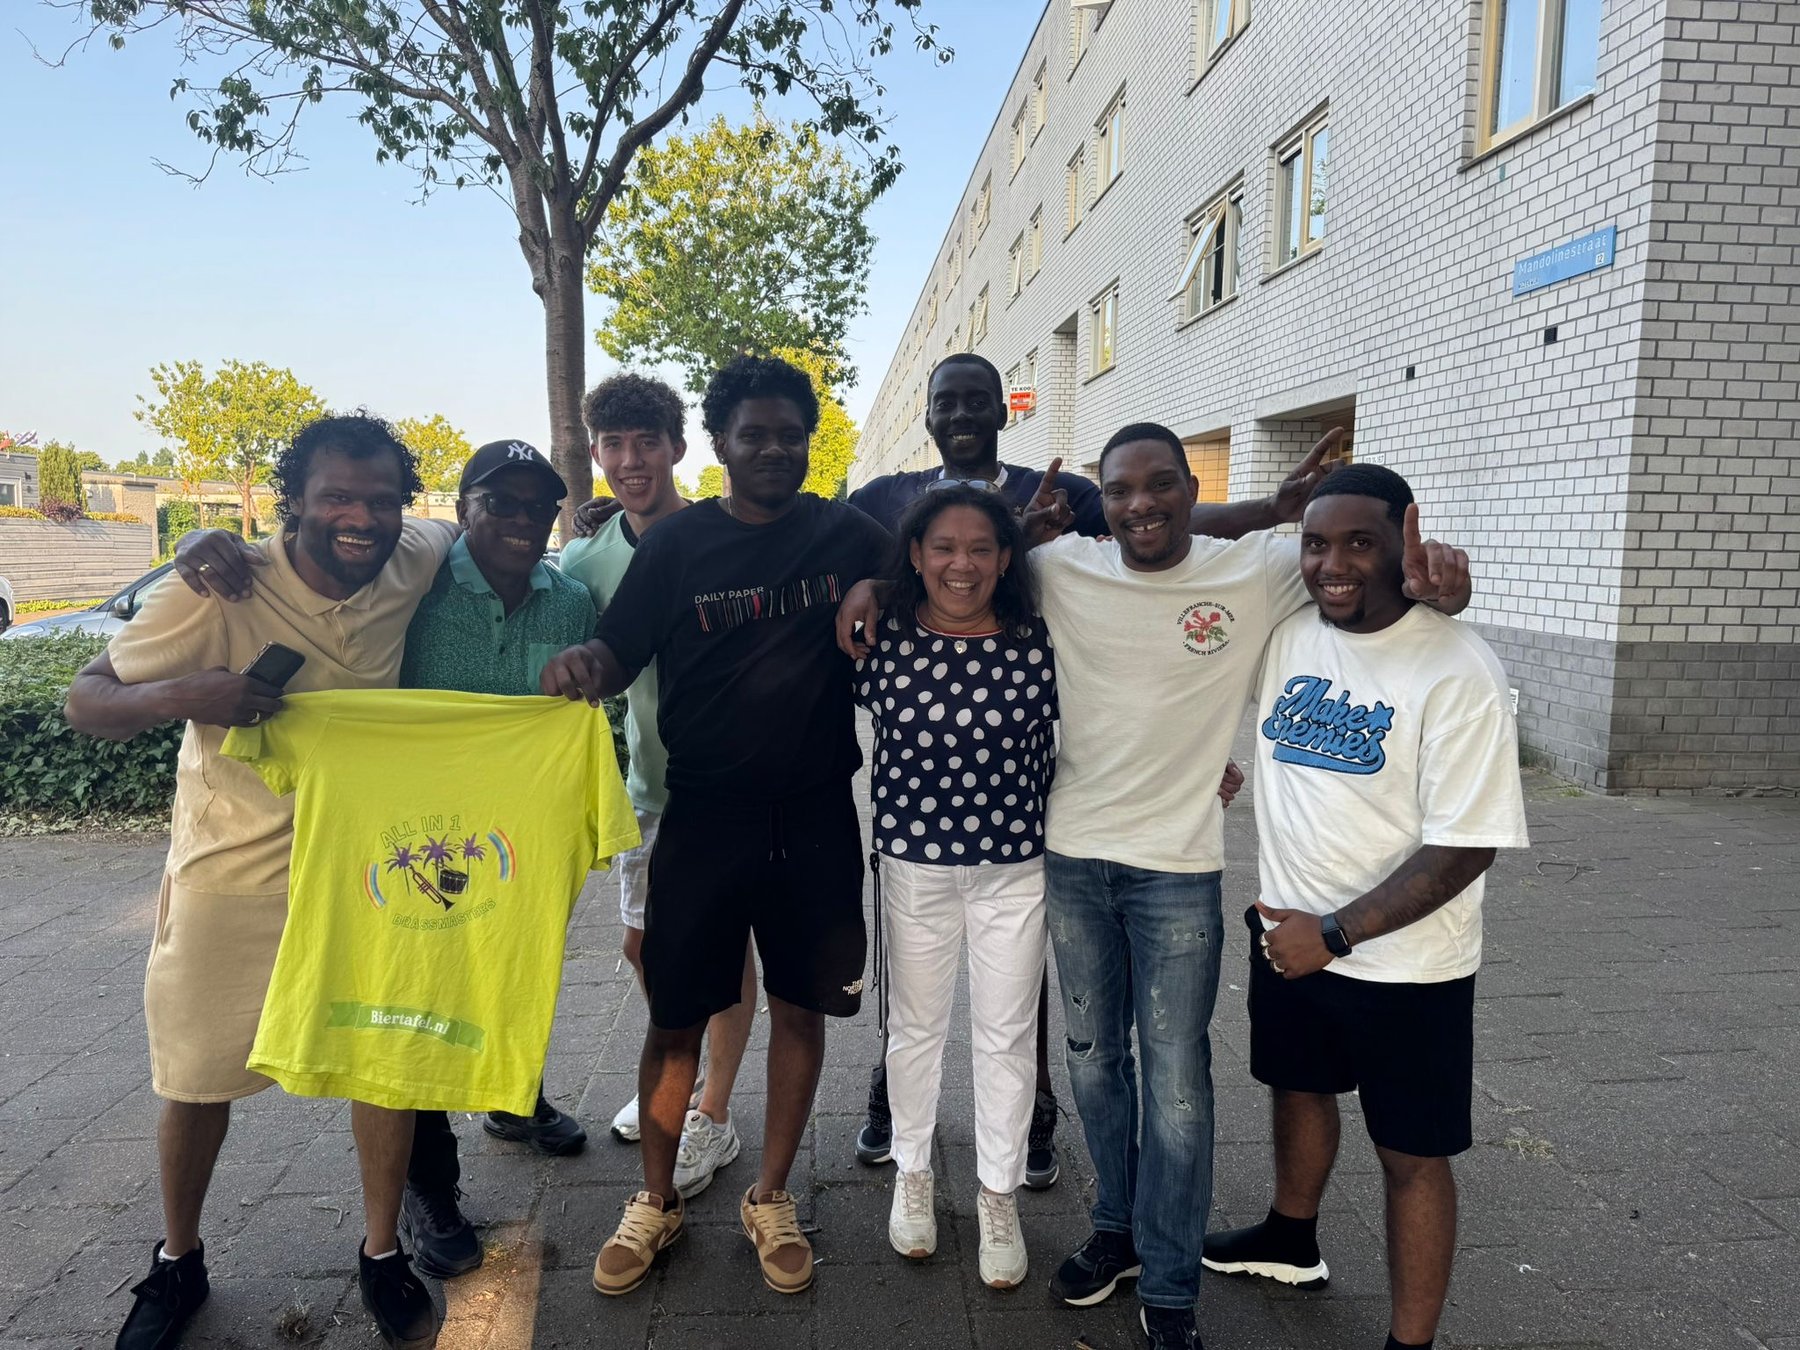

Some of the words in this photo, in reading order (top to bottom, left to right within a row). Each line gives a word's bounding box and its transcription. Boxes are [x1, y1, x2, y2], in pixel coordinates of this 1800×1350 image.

[1518, 233, 1607, 276] Mandolinestraat
[507, 442, 534, 460] NY
[694, 591, 726, 605] DAILY
[728, 586, 765, 600] PAPER
[1184, 643, 1206, 656] FRENCH
[1278, 675, 1369, 733] Make
[1262, 695, 1386, 764] Enemies
[380, 821, 418, 849] ALL
[421, 815, 443, 832] IN
[449, 815, 462, 831] 1
[391, 898, 497, 931] BRASSMASTERS
[371, 1010, 451, 1035] Biertafel.nl
